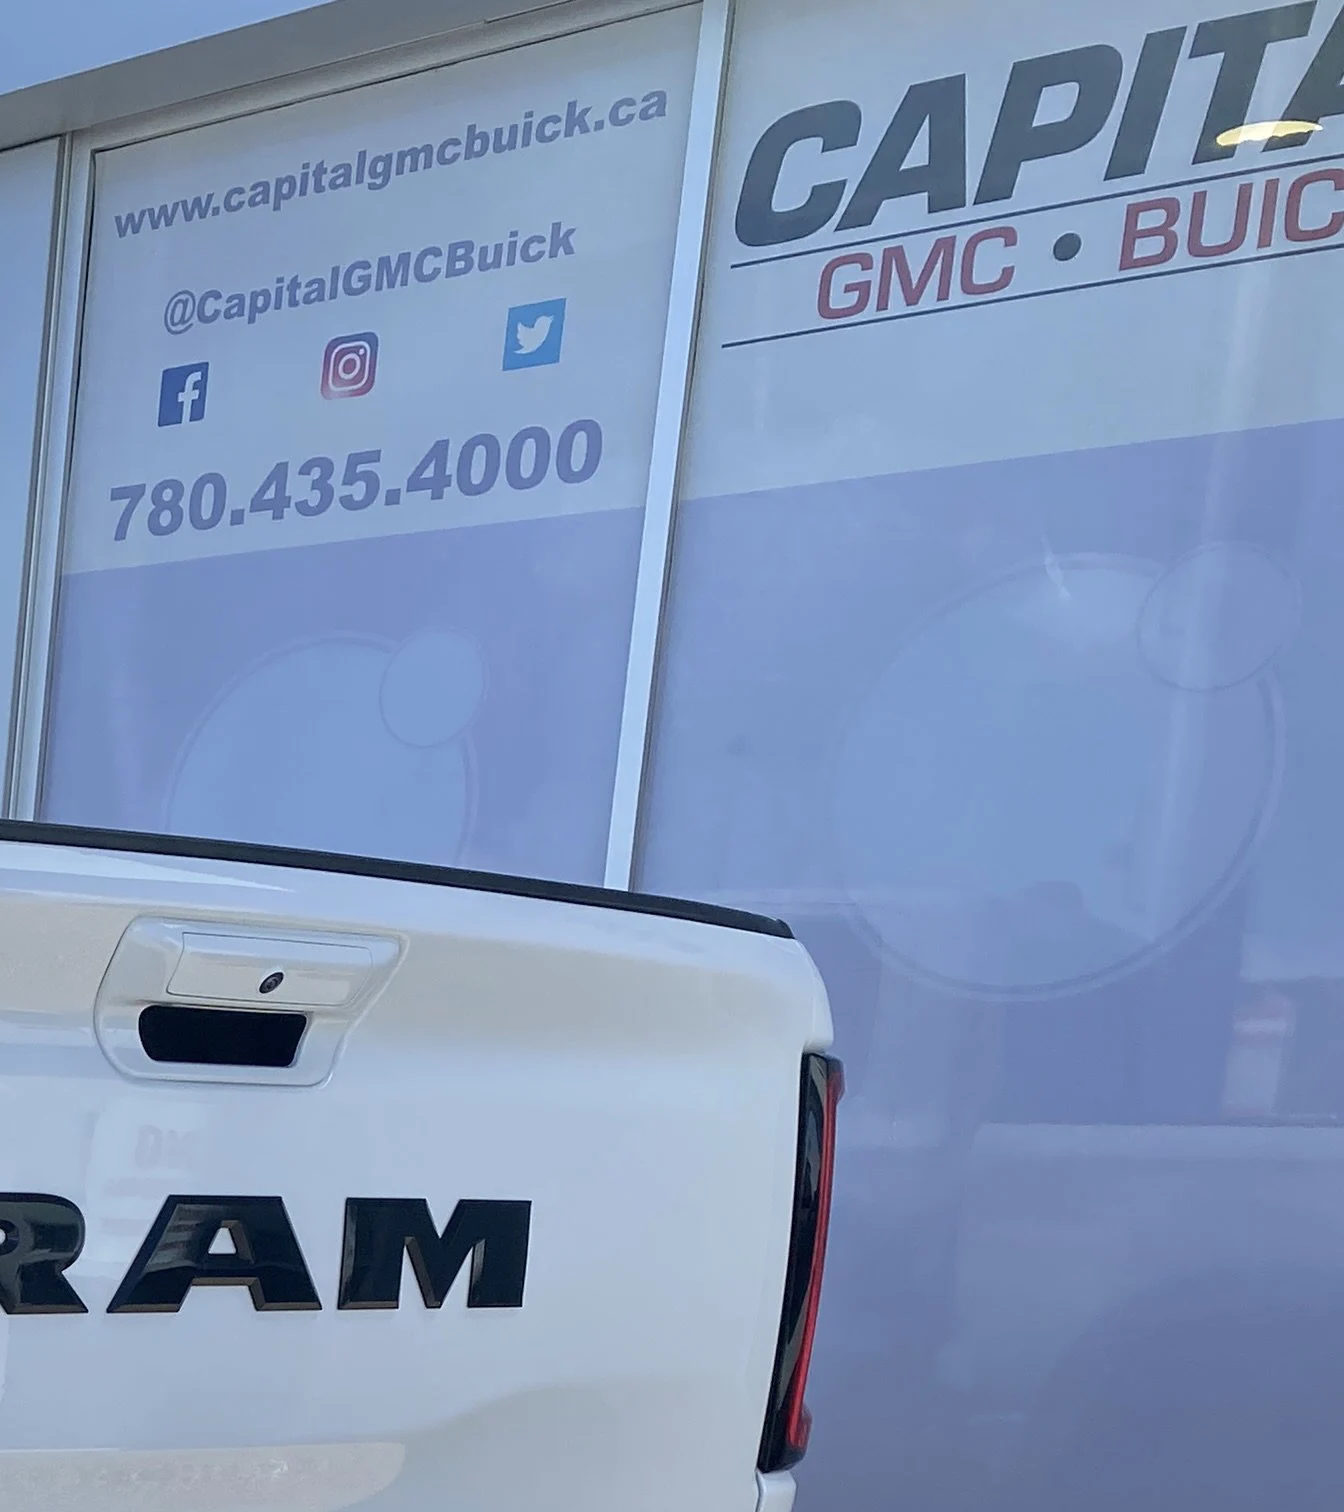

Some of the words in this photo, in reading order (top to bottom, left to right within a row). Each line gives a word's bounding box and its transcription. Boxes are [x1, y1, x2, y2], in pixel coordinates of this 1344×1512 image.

[114, 90, 668, 238] www.capitalgmcbuick.ca
[164, 222, 576, 334] @CapitalGMCBuick
[817, 227, 1017, 320] GMC
[1119, 168, 1344, 272] BUIC
[110, 418, 603, 541] 780.435.4000
